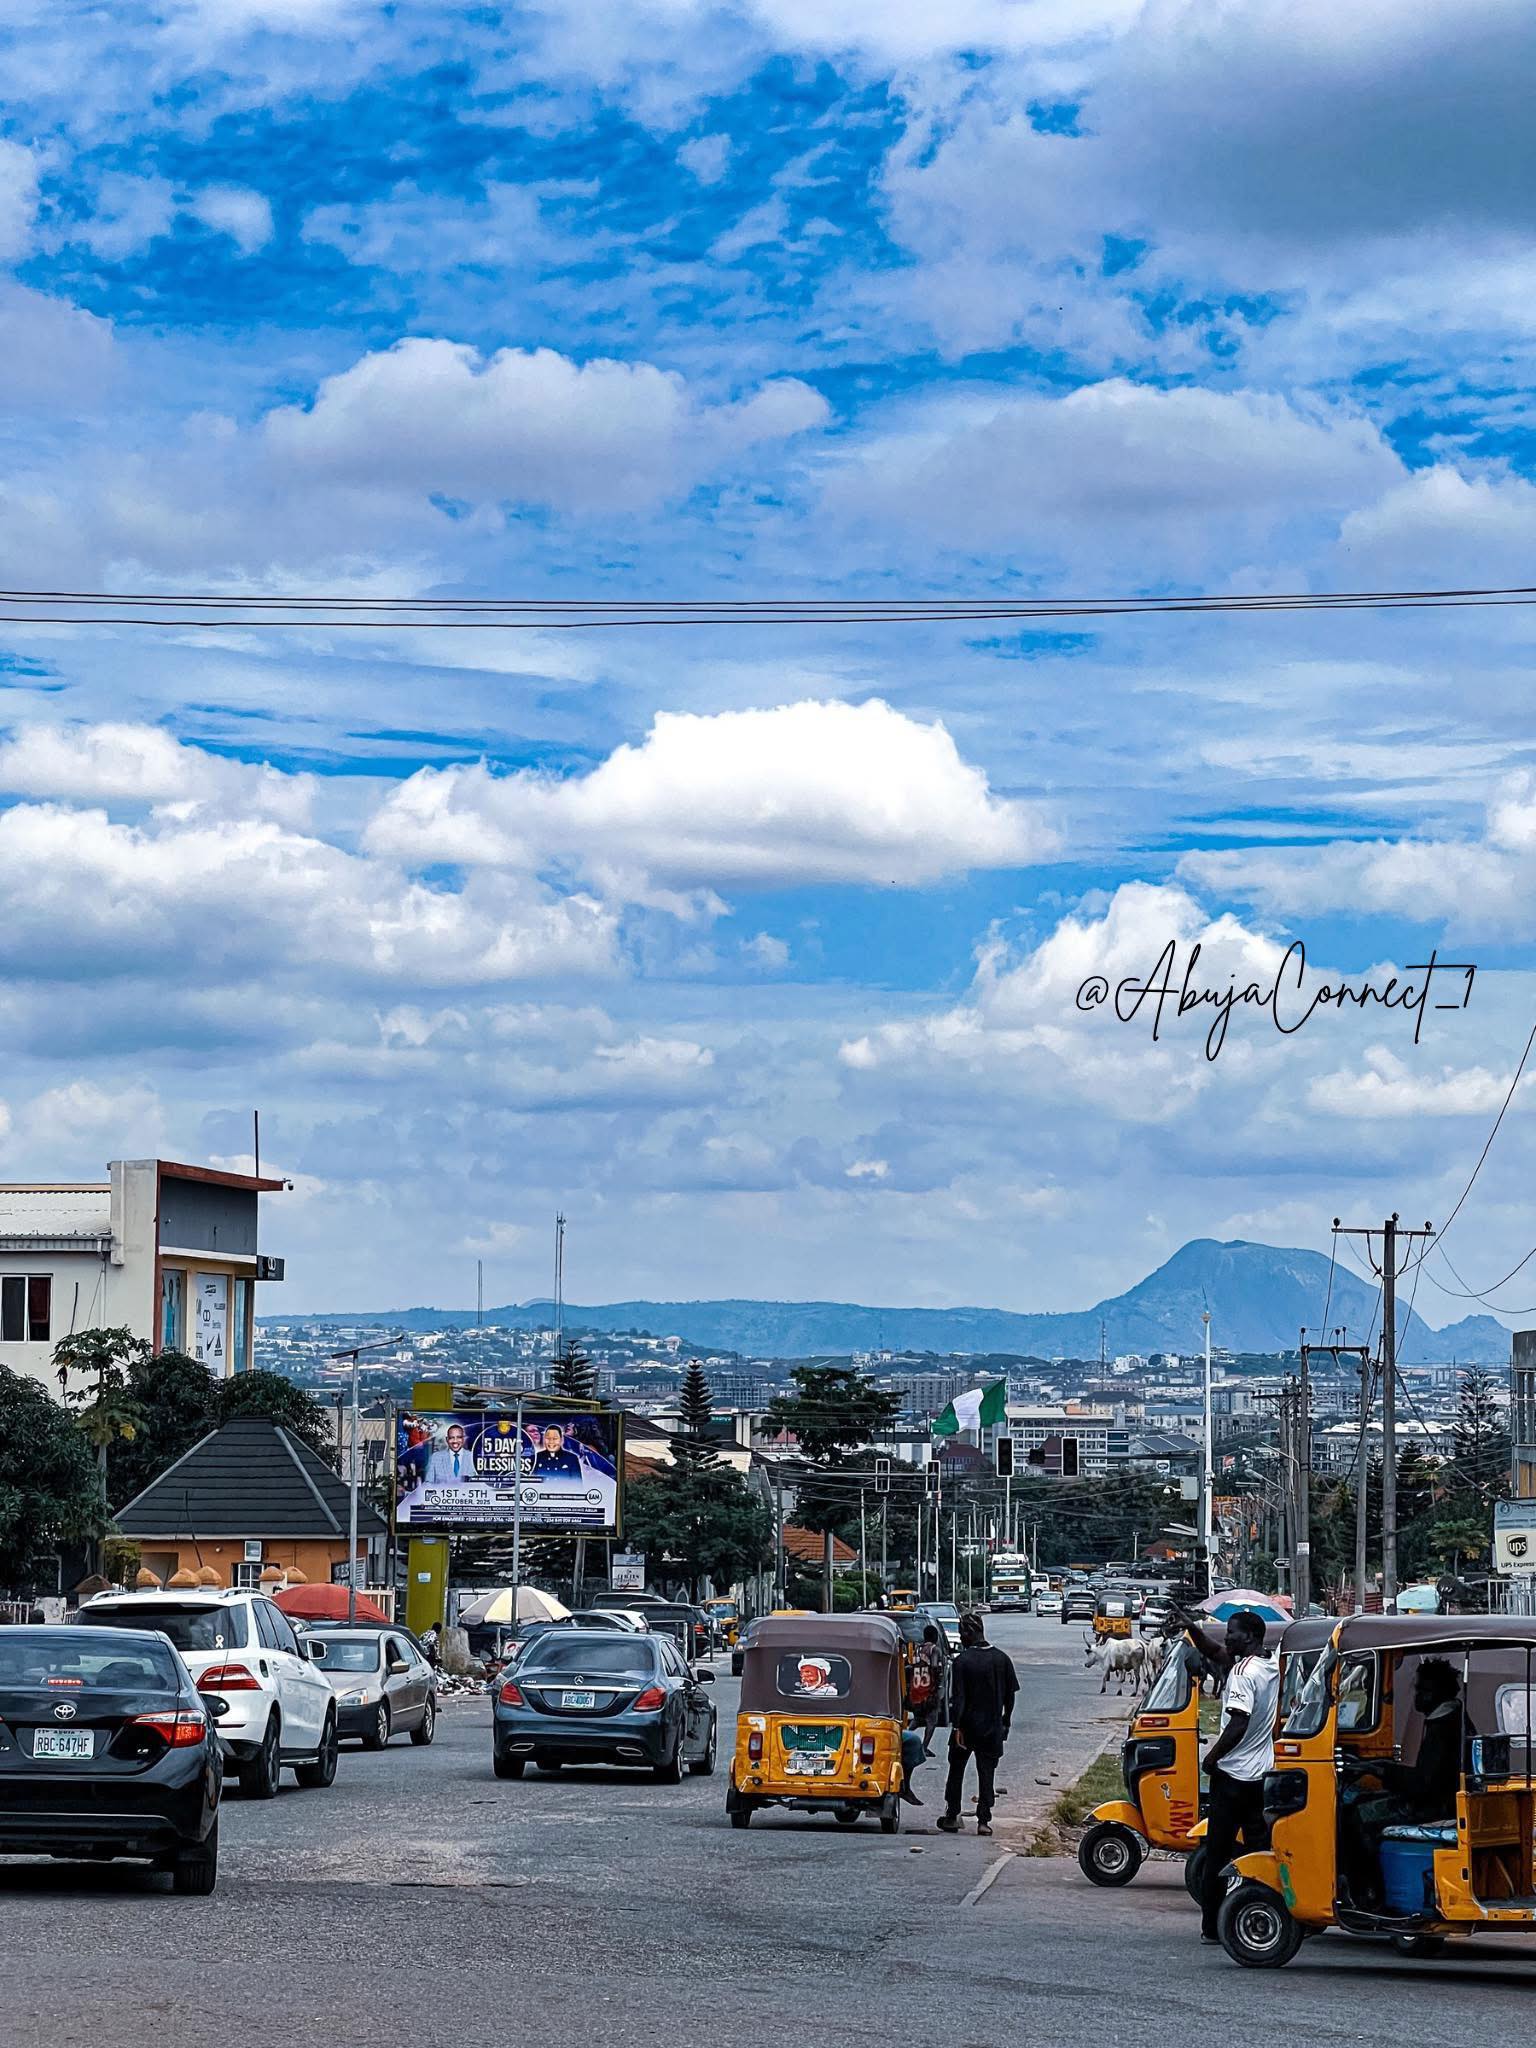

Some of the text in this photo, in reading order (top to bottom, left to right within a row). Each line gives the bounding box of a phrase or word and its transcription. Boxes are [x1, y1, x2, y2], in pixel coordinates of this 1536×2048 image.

[484, 1438, 492, 1453] 5
[477, 1458, 532, 1472] BLESSINGS
[440, 1490, 459, 1498] 1ST
[468, 1490, 488, 1498] 5TH
[1509, 1542, 1527, 1556] ups
[37, 1737, 90, 1752] RBC-647HF
